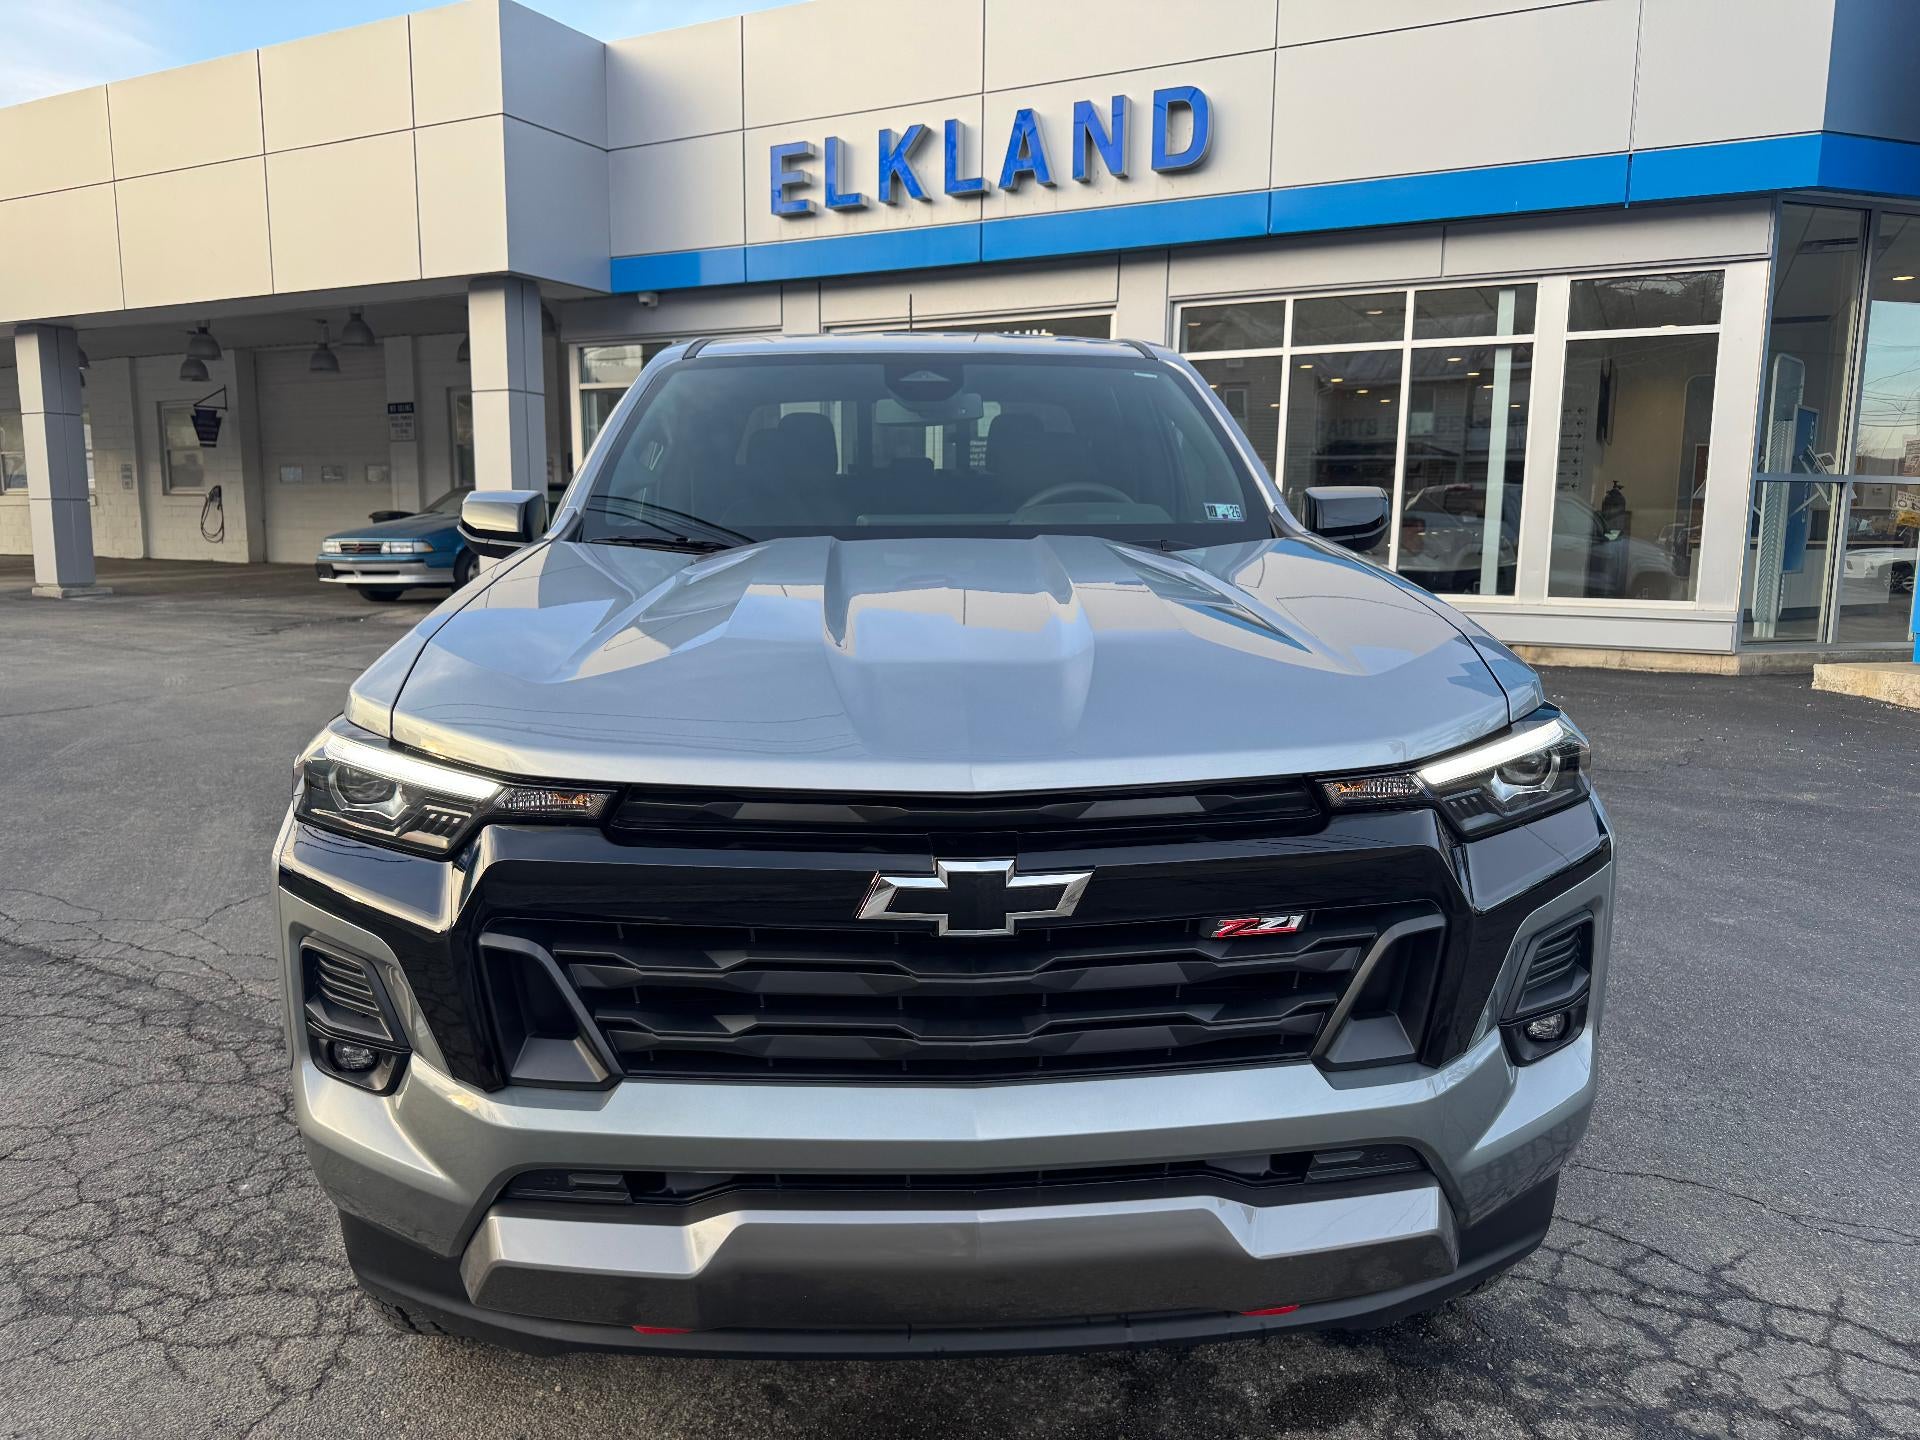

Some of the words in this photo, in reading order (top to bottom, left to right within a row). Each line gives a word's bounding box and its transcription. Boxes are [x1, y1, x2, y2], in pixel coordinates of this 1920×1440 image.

[770, 85, 1213, 217] ELKLAND
[1230, 505, 1241, 518] 26
[1210, 914, 1305, 938] Z71
